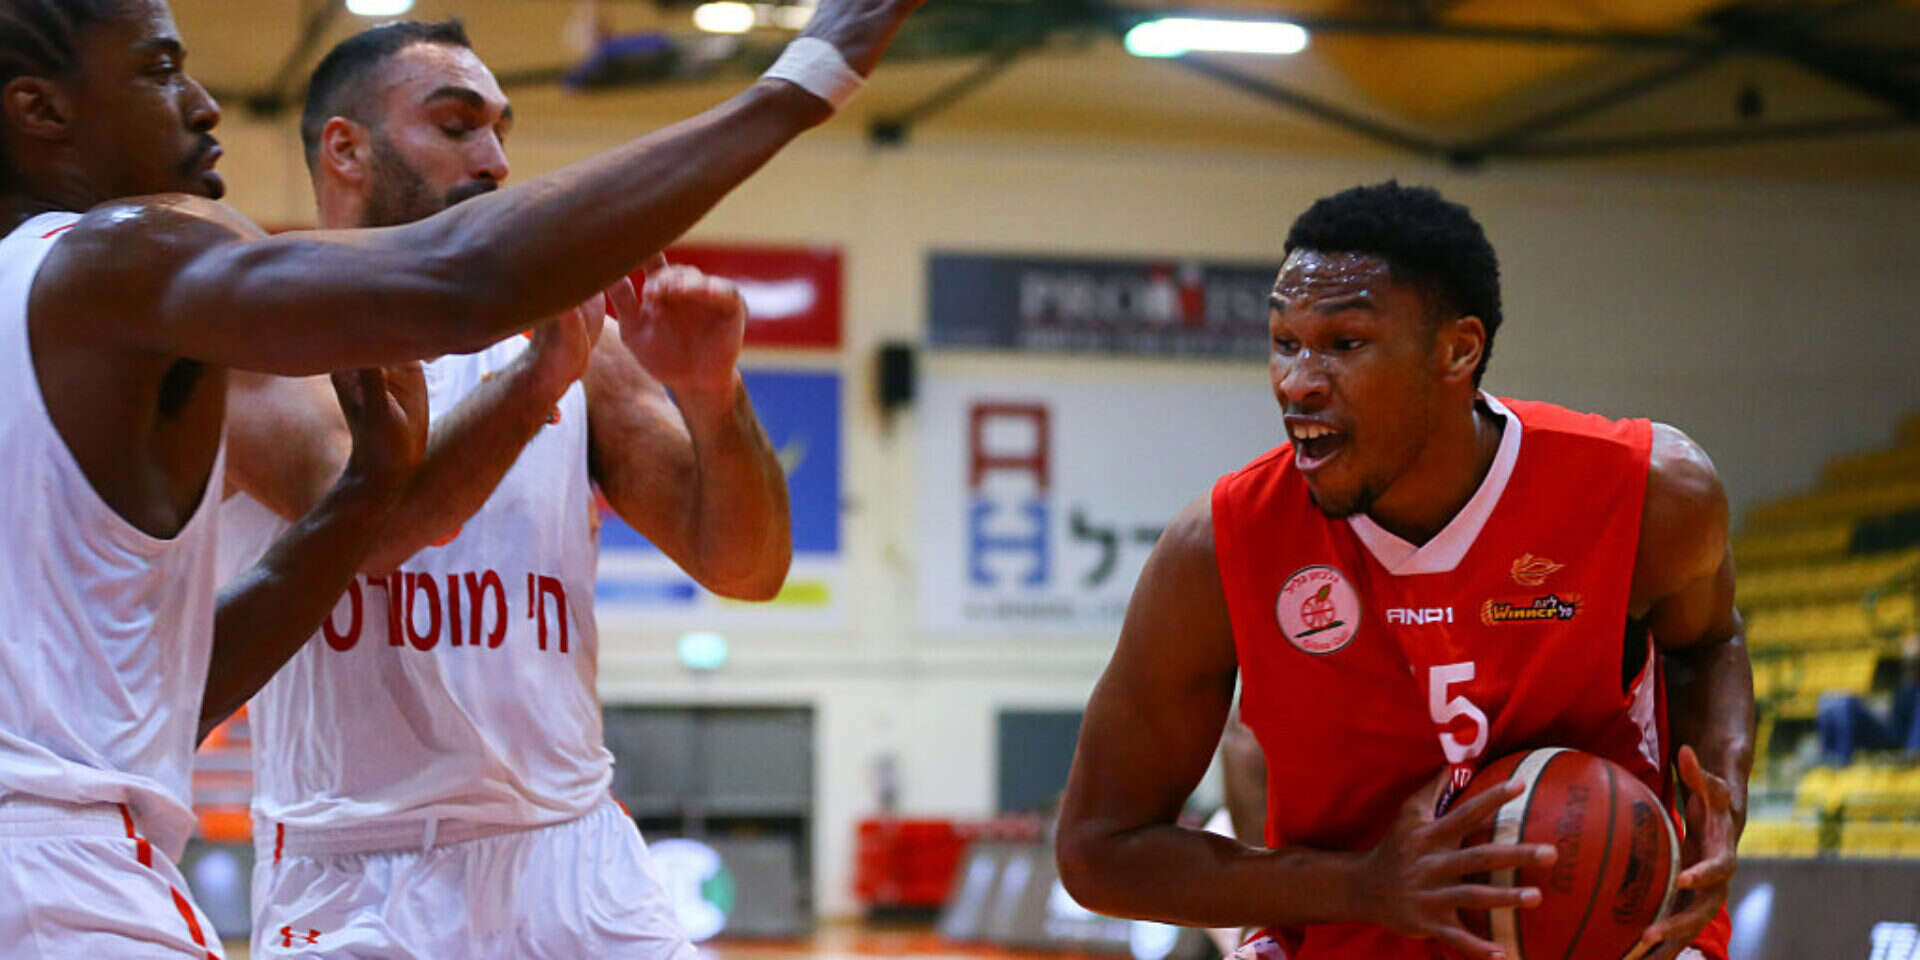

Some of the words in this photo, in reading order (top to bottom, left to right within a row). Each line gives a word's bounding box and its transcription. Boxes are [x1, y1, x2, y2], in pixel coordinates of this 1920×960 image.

[528, 572, 569, 654] חי
[1493, 605, 1557, 619] Winner
[1429, 661, 1489, 764] 5
